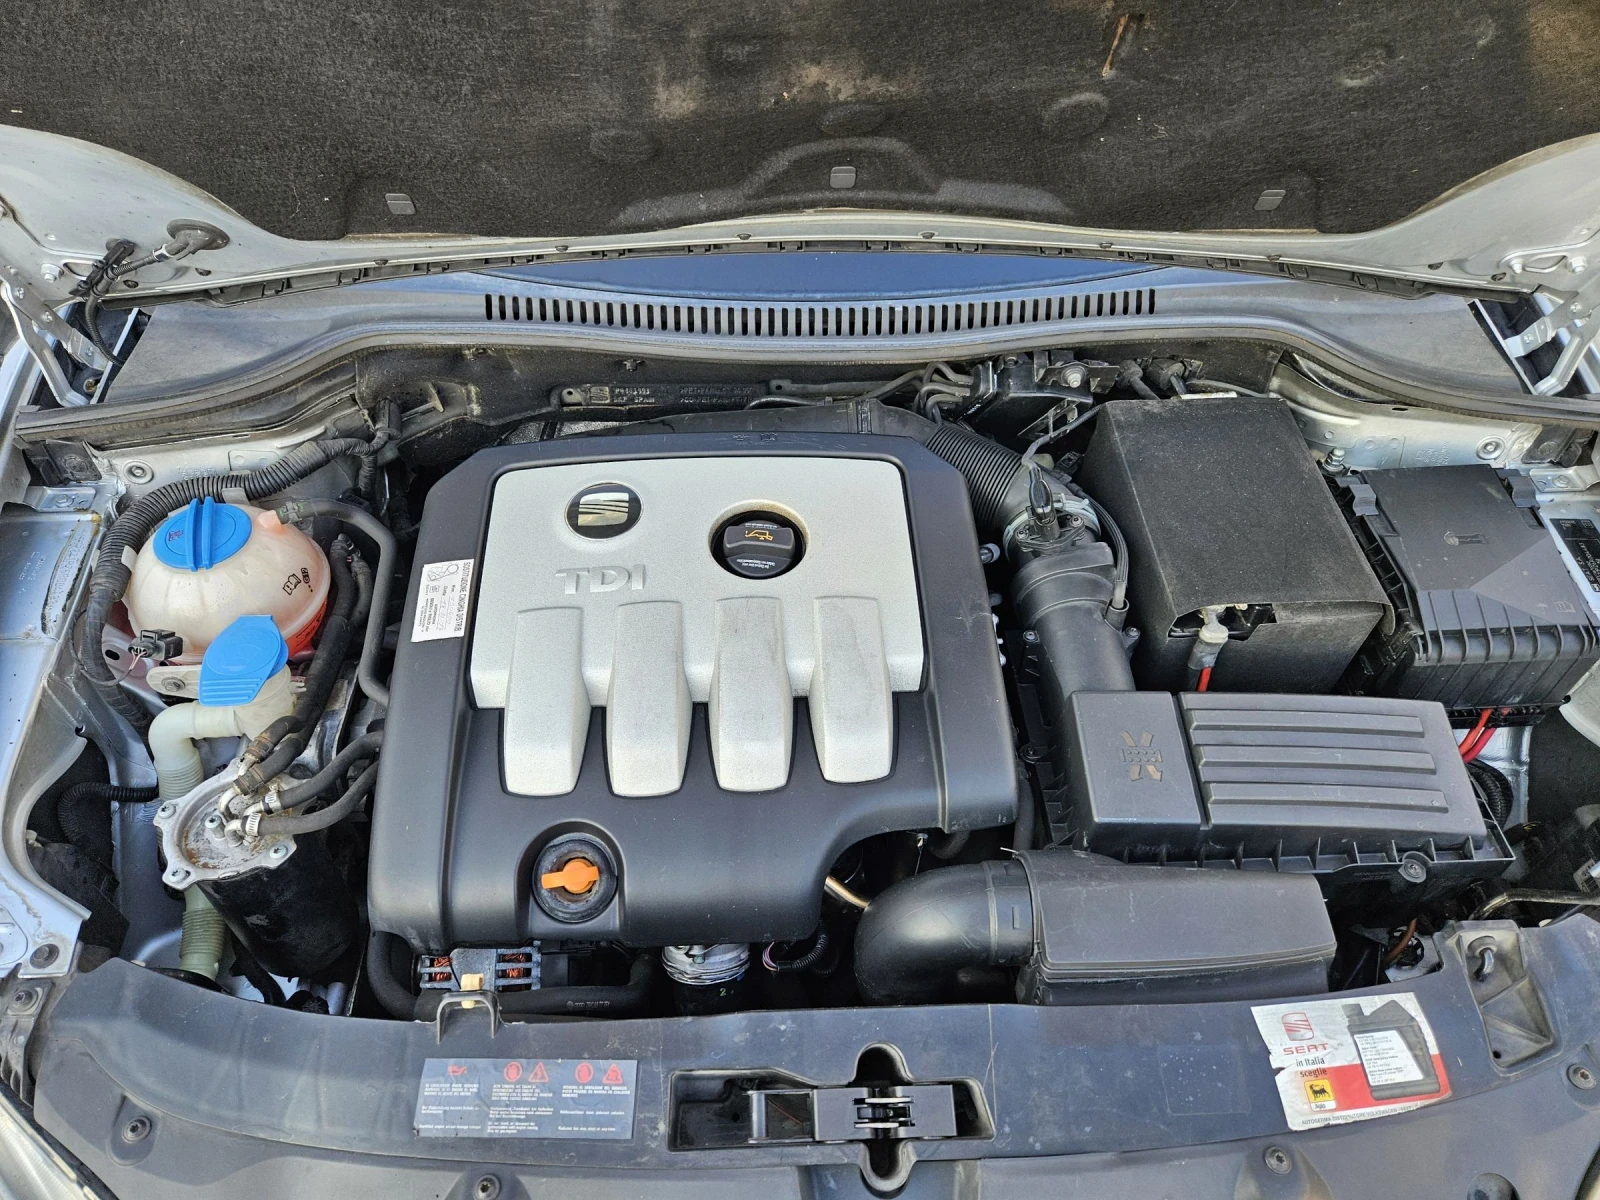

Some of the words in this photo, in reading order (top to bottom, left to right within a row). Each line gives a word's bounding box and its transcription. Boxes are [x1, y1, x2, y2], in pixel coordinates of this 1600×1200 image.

[556, 564, 646, 594] TDI
[720, 988, 726, 996] 2
[1283, 1043, 1328, 1056] SEAT
[1296, 1058, 1304, 1067] in
[1304, 1056, 1325, 1066] Italia
[1300, 1068, 1328, 1078] sceglie
